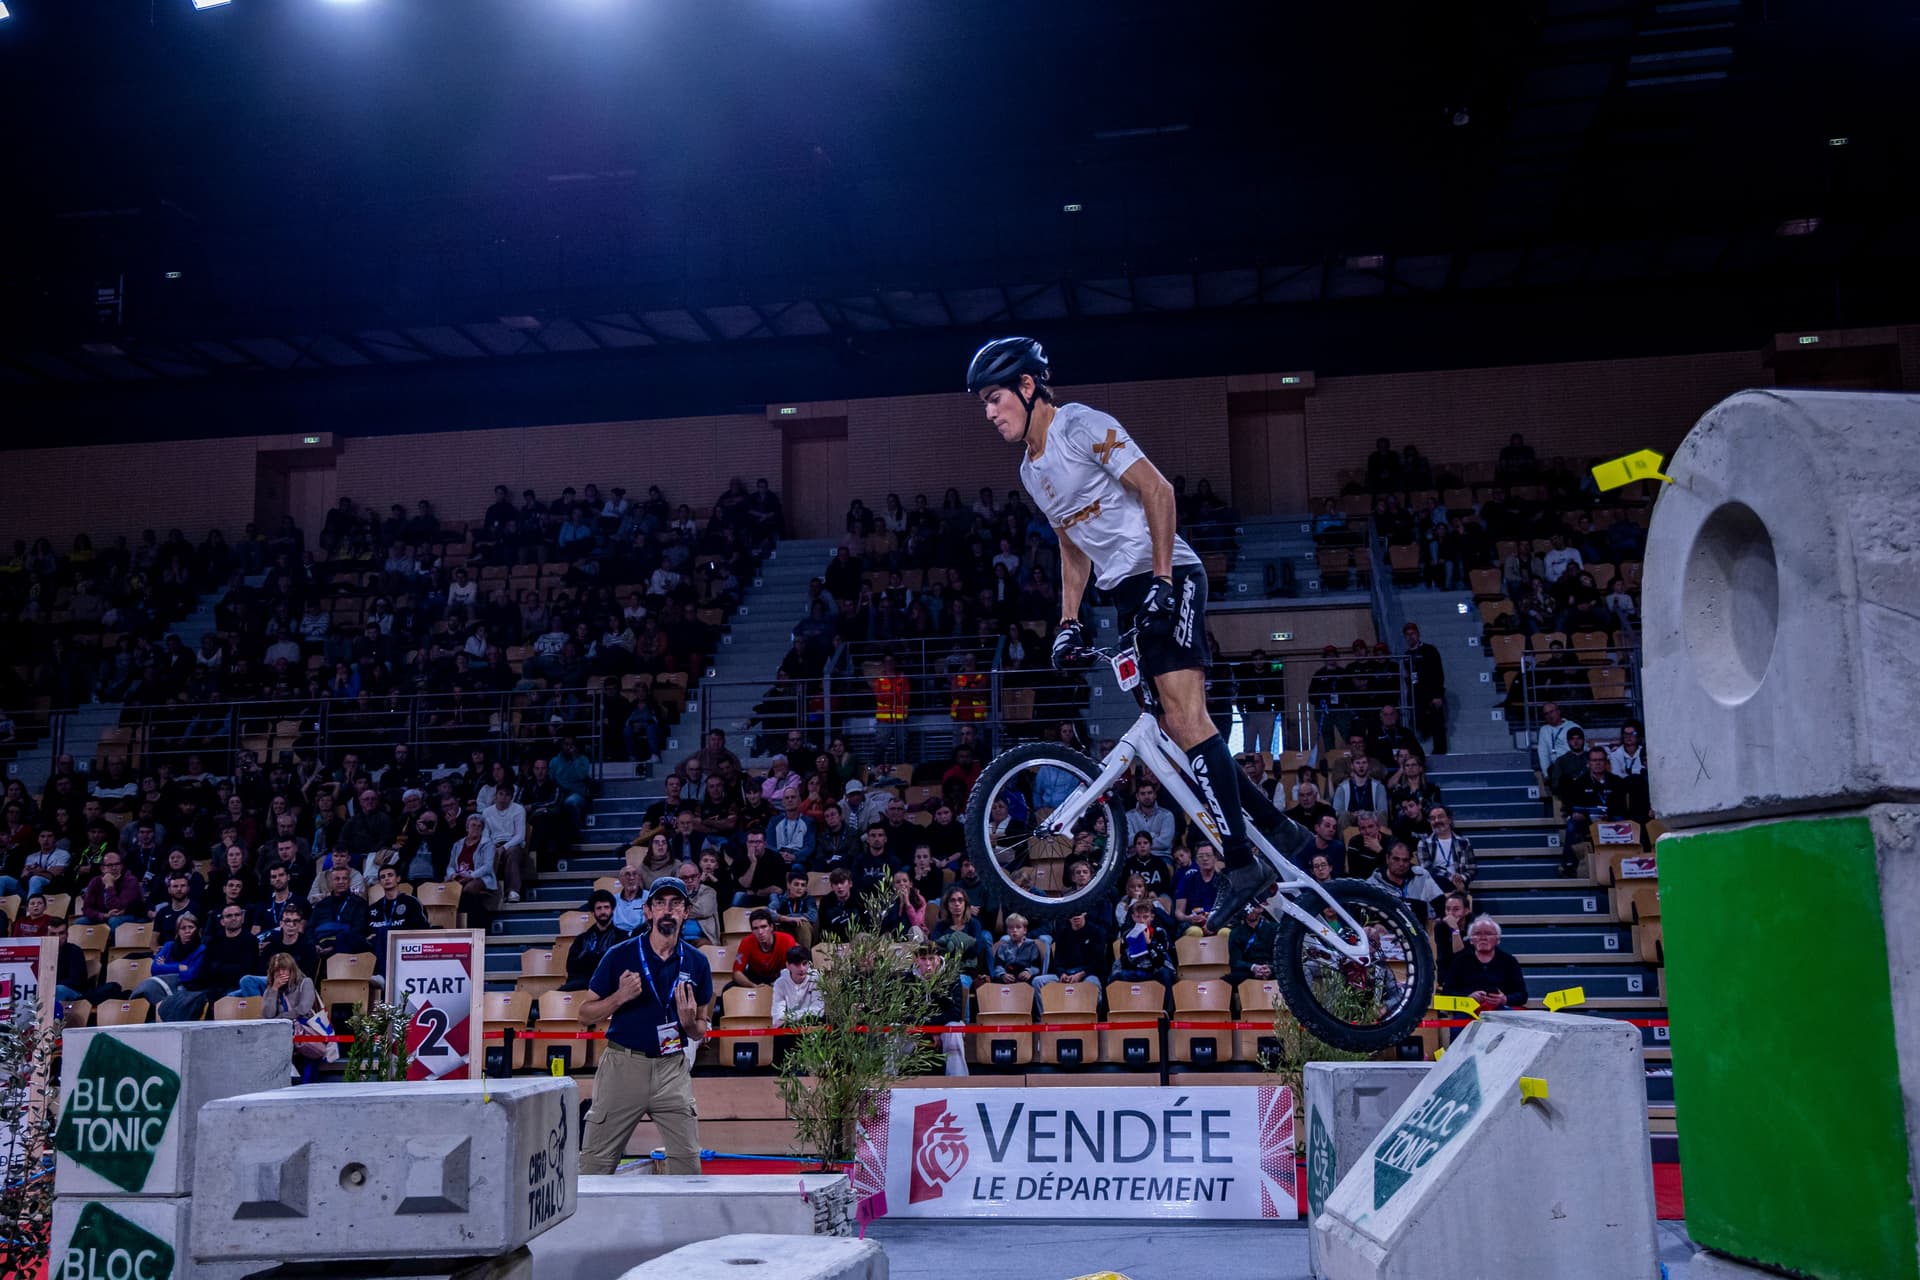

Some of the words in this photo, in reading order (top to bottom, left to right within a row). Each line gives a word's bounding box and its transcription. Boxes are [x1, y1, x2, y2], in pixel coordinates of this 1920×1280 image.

[1197, 775, 1232, 836] CLEAN
[405, 977, 466, 994] START
[416, 1007, 449, 1057] 2
[72, 1075, 165, 1112] BLOC
[72, 1116, 163, 1153] TONIC
[976, 1096, 1234, 1163] VENDÉE
[1406, 1095, 1469, 1137] BLOC
[528, 1149, 547, 1186] CIRO
[1380, 1129, 1440, 1173] TONIC
[528, 1180, 556, 1230] TRIAL
[973, 1176, 1006, 1201] LE
[1016, 1171, 1235, 1202] DÉPARTEMENT
[63, 1247, 158, 1280] BLOC
